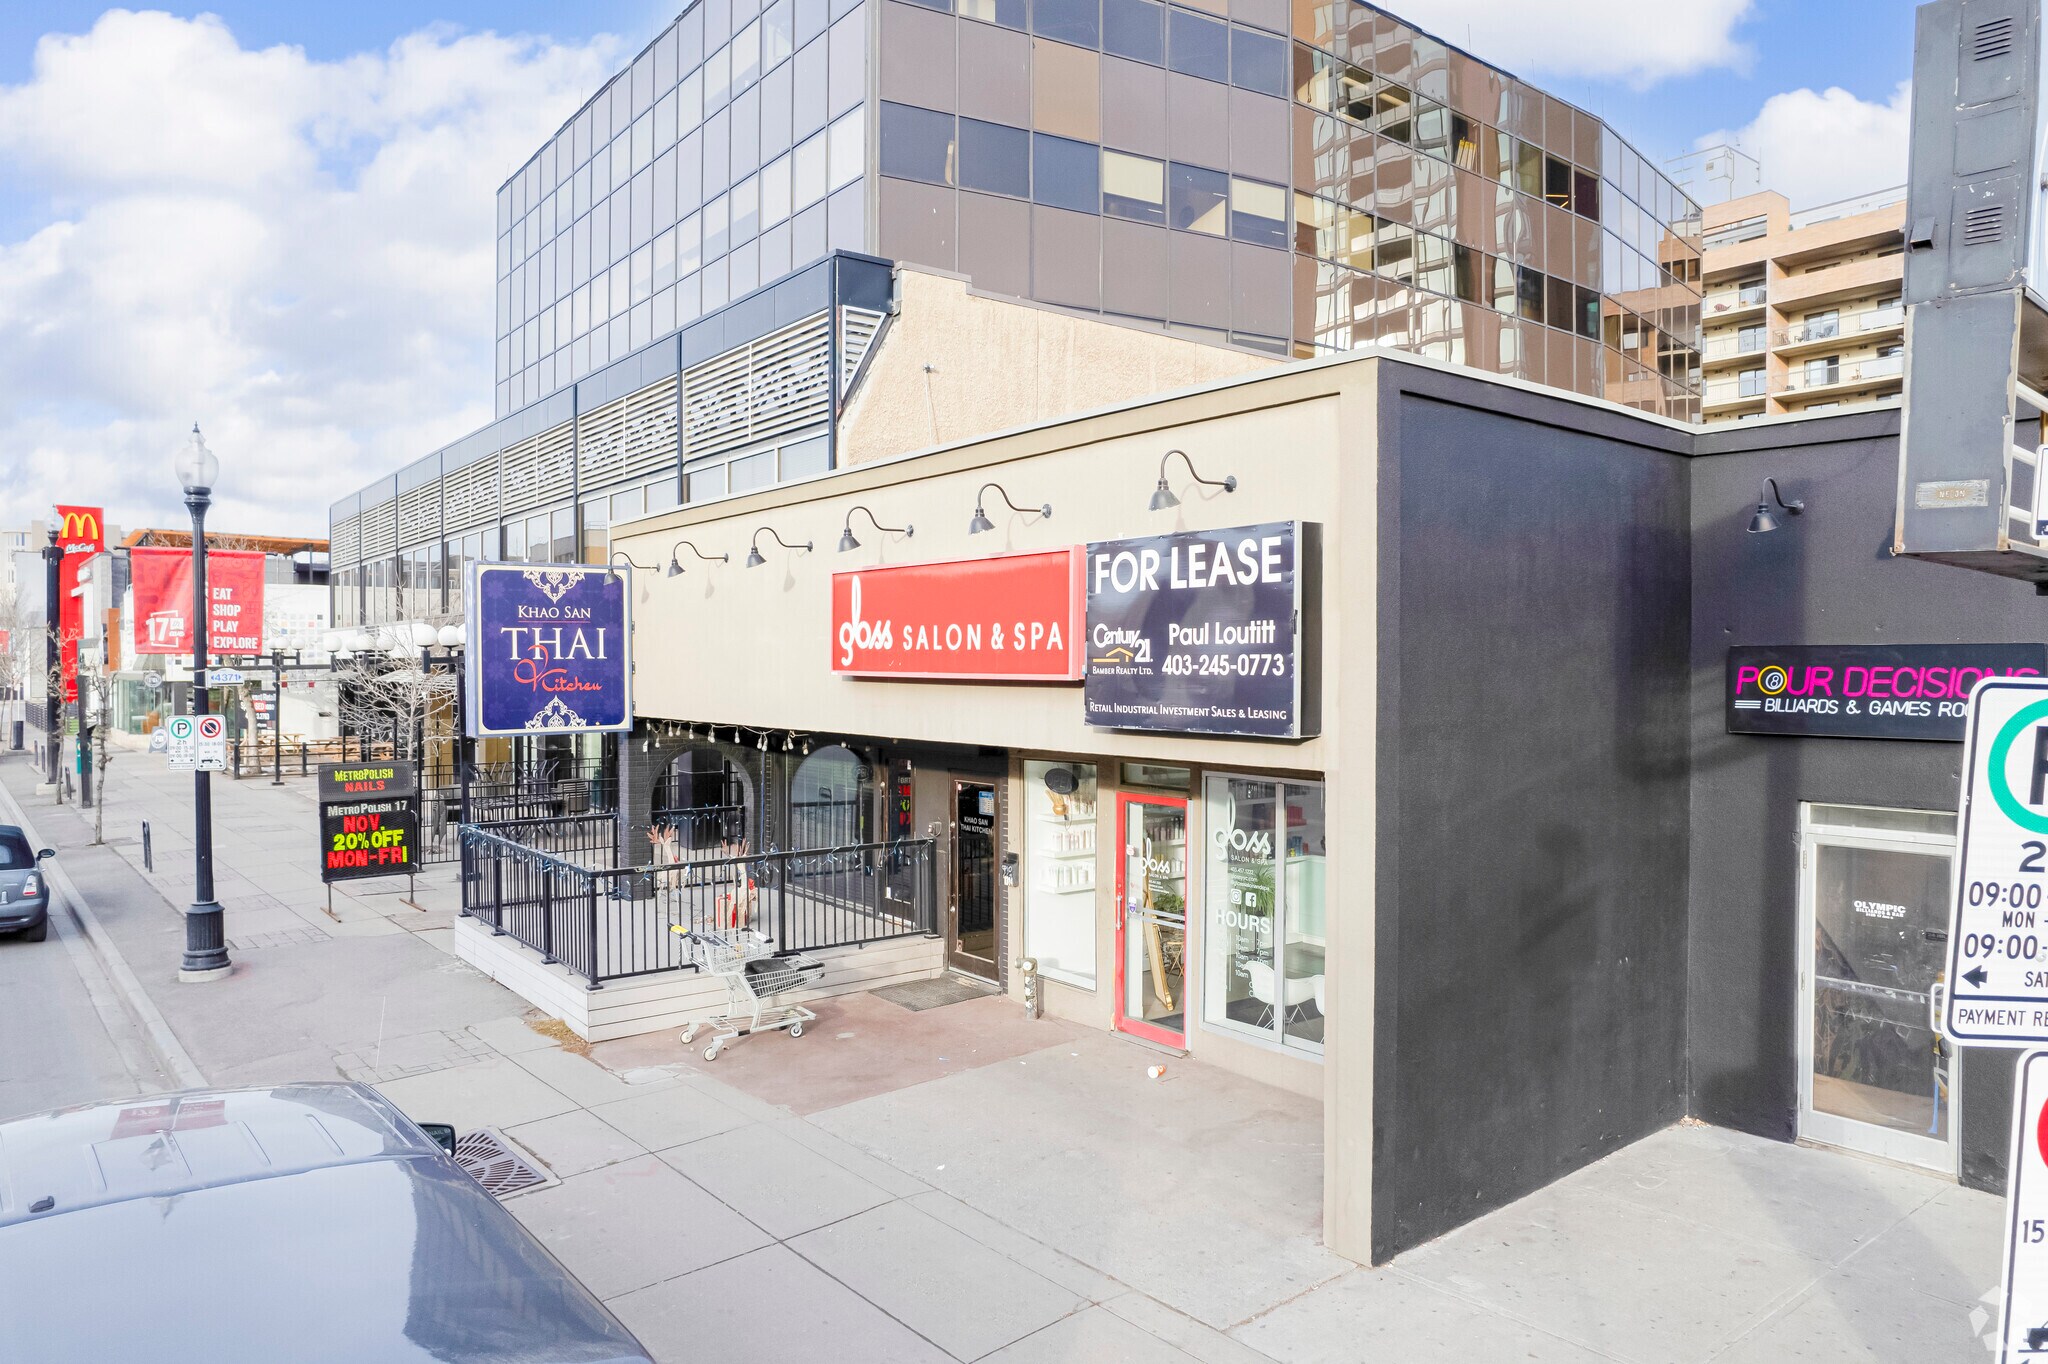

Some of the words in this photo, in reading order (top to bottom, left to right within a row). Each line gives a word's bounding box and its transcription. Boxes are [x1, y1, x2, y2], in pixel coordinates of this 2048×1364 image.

[1095, 549, 1160, 594] FOR
[1170, 536, 1282, 590] LEASE
[213, 588, 232, 600] EAT
[212, 604, 241, 616] SHOP
[518, 605, 560, 618] KHAO
[564, 606, 591, 619] SAN
[838, 574, 893, 666] gloss
[902, 623, 981, 650] SALON
[990, 622, 1004, 650] &
[1013, 622, 1064, 650] SPA
[146, 618, 170, 641] 17
[213, 620, 238, 632] PLAY
[1093, 622, 1140, 648] Century
[1168, 622, 1209, 646] Paul
[1215, 620, 1276, 645] Loutitt
[214, 636, 258, 649] EXPLORE
[500, 628, 608, 660] THAI
[514, 644, 602, 692] Kitchen
[1162, 654, 1284, 676] 403-245-0773
[1736, 666, 1834, 696] POUR
[1842, 666, 2040, 698] DECISIO
[1090, 701, 1112, 712] RETAIL
[1114, 702, 1158, 714] INDUSTRIAL
[1160, 704, 1209, 716] INVESTMENT
[1211, 706, 1236, 717] SALES
[1238, 709, 1246, 718] &
[1248, 707, 1286, 719] LEASING
[1764, 698, 1838, 714] BILLIARDS
[1846, 700, 1861, 714] &
[1868, 700, 1932, 716] GAMES
[1938, 702, 1969, 718] RO
[344, 780, 385, 792] NAILS
[394, 800, 407, 811] 17
[960, 824, 971, 832] THAI
[972, 826, 993, 835] KITCHEN
[964, 816, 978, 824] KHAO
[1214, 792, 1271, 861] gloss
[333, 832, 369, 851] 20%
[371, 829, 404, 848] OFF
[327, 846, 408, 869] MON-FRI
[1140, 838, 1170, 876] gloss
[1230, 854, 1249, 863] SALON
[2019, 840, 2046, 873] 2
[1969, 881, 2042, 909] 09:00
[1854, 900, 1906, 914] OLYMPIC
[1215, 909, 1270, 934] HOURS
[2002, 911, 2035, 928] MON
[1958, 1008, 2026, 1026] PAYMENT
